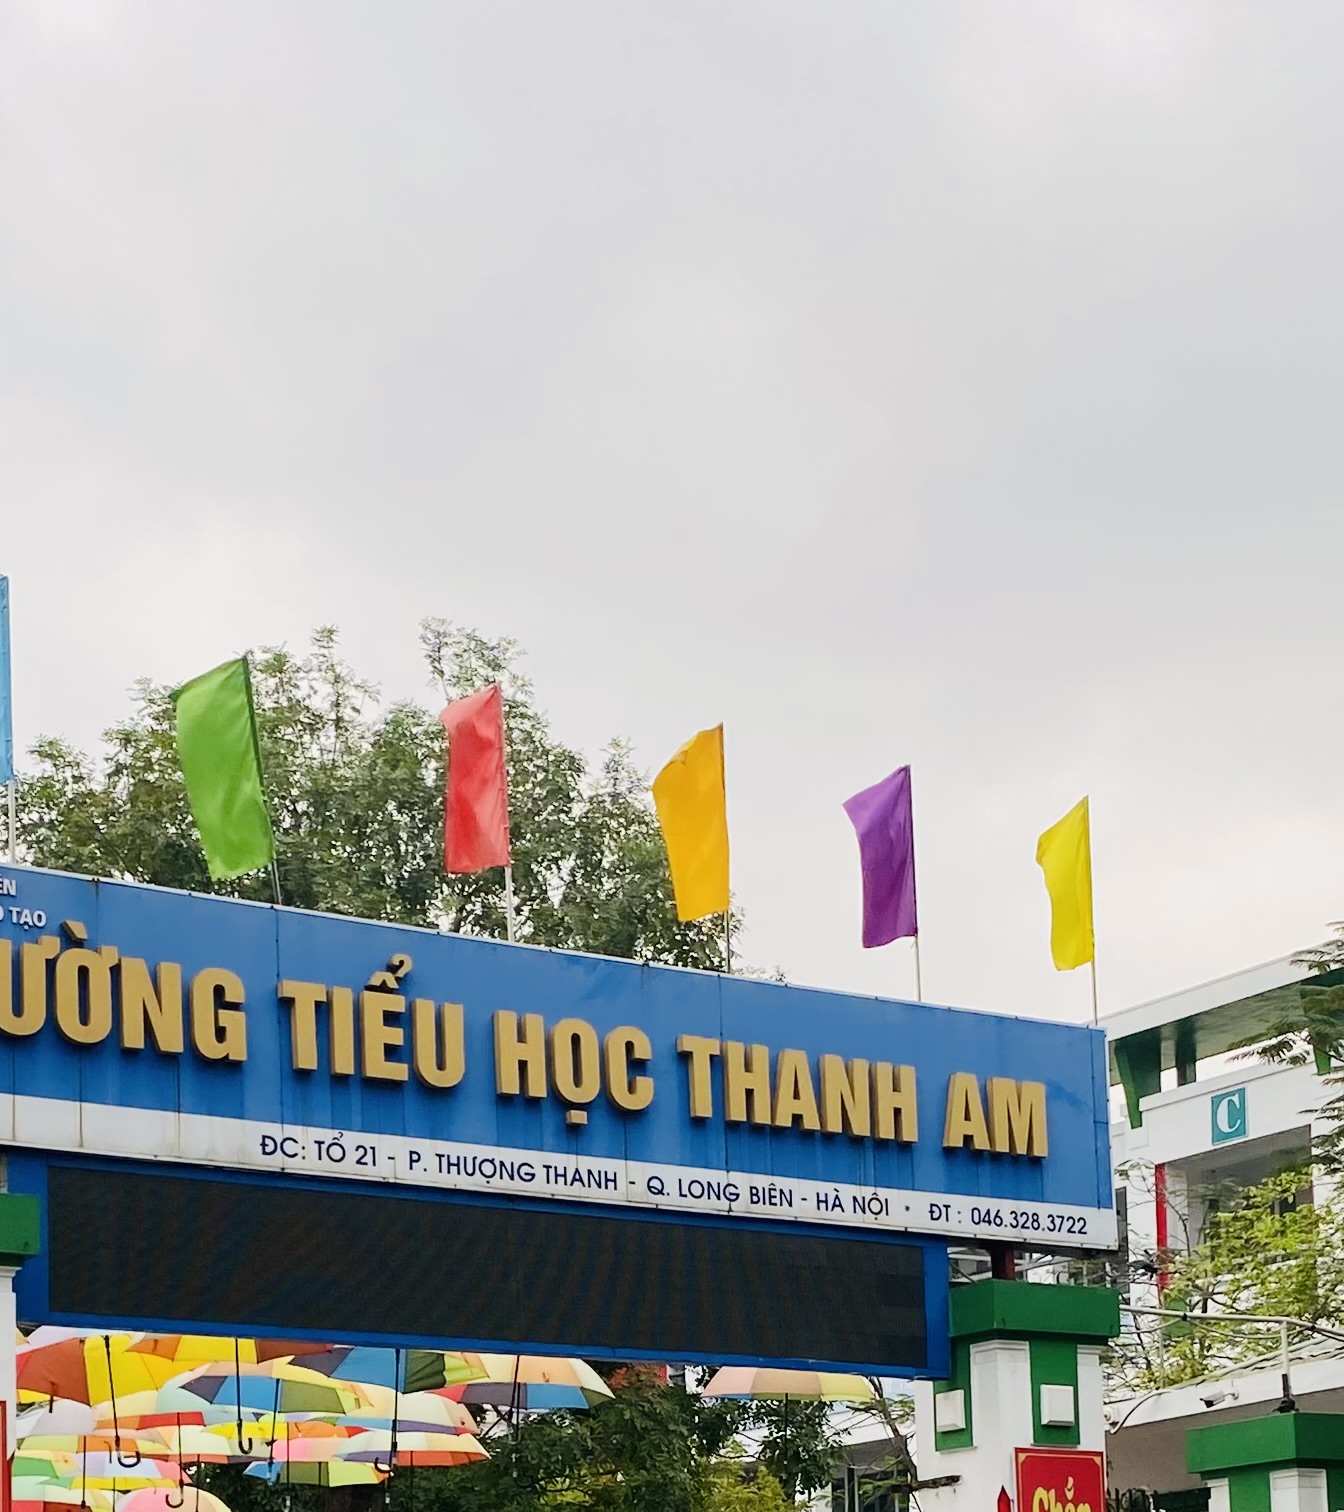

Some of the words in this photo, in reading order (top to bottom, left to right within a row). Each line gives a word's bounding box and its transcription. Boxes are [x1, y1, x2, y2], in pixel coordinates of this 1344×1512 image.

[9, 907, 47, 930] TẠO
[278, 952, 465, 1089] TIỂU
[492, 1009, 654, 1126] HỌC
[676, 1034, 918, 1144] THANH
[942, 1072, 1049, 1158] AM
[1216, 1093, 1241, 1132] C
[260, 1135, 306, 1160] ĐC:
[314, 1131, 347, 1163] TỔ
[355, 1145, 377, 1167] 21
[409, 1150, 428, 1172] P.
[435, 1153, 536, 1185] THƯỢNG
[542, 1164, 618, 1191] THANH
[646, 1175, 670, 1197] Q.
[678, 1178, 741, 1203] LONG
[749, 1183, 794, 1209] BIÊN
[816, 1188, 845, 1213] HÀ
[853, 1194, 890, 1221] NỘI
[970, 1207, 1089, 1236] 046.328.3722
